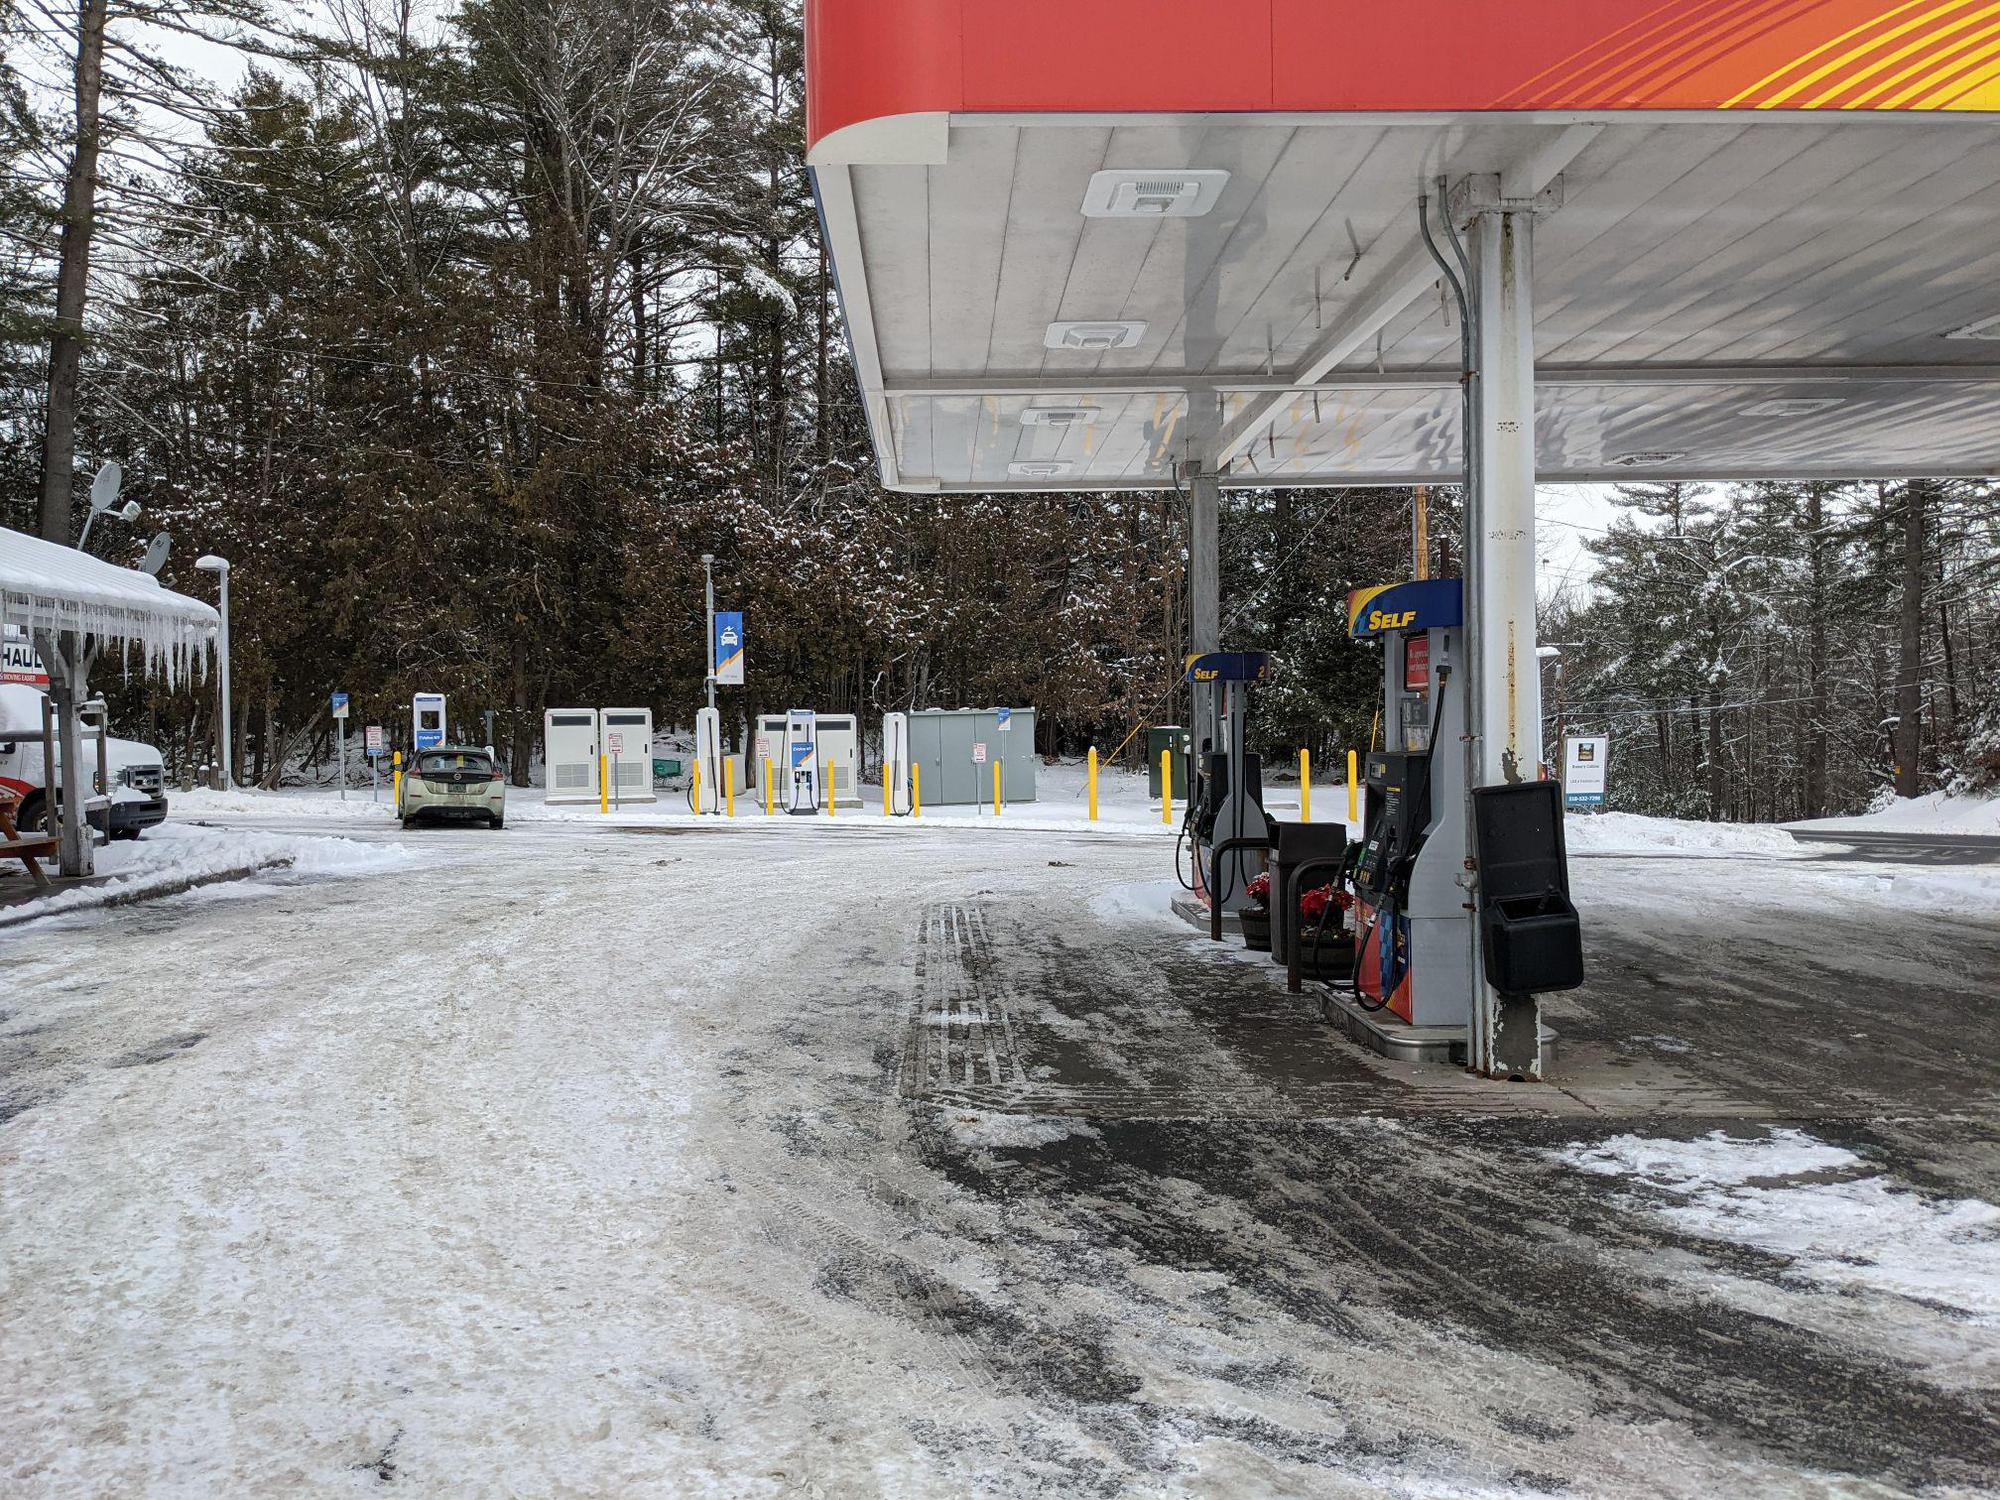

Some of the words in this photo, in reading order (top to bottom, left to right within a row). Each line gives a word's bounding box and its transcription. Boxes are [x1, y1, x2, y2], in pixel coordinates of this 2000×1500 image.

[1369, 610, 1417, 631] SELF
[1194, 667, 1218, 680] SELF
[1258, 665, 1265, 678] 2
